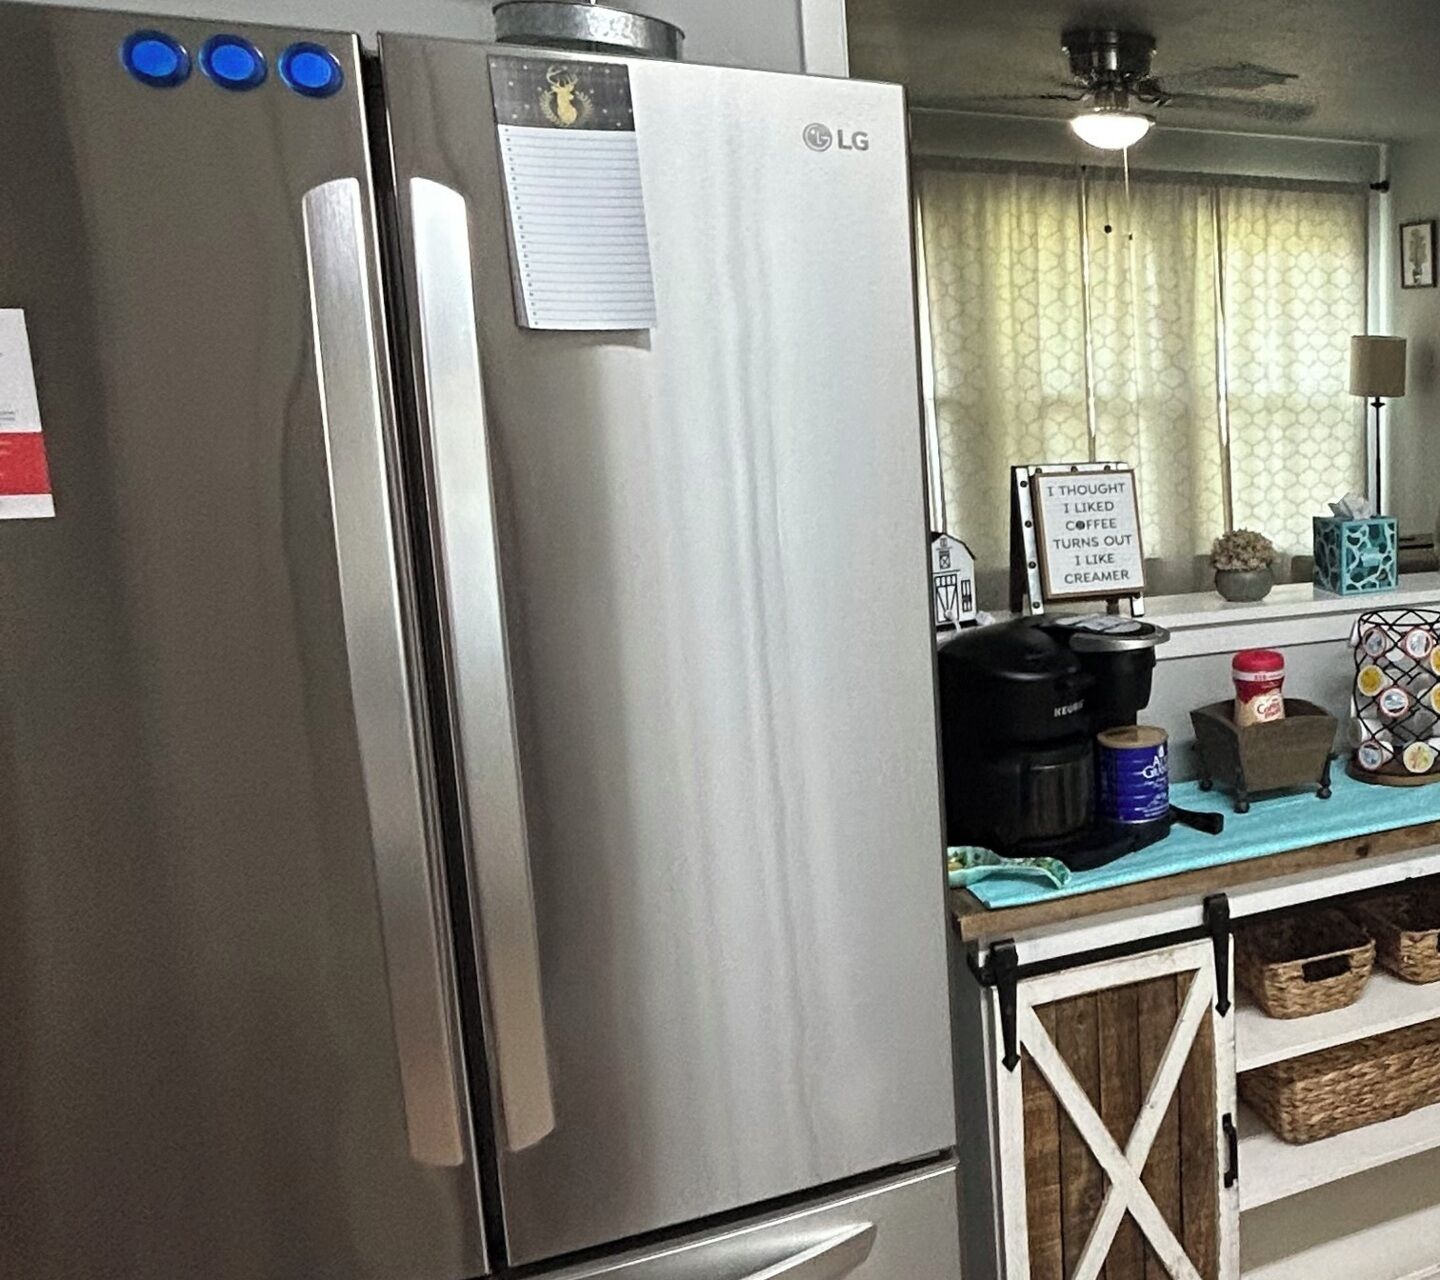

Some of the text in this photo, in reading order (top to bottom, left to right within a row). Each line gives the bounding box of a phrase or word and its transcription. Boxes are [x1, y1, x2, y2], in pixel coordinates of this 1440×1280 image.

[837, 129, 869, 151] LG
[1047, 482, 1125, 496] I THOUGHT
[1063, 501, 1114, 513] I LIKED
[1065, 518, 1117, 531] COFFEE
[1053, 535, 1132, 549] TURNS OUT
[1075, 553, 1115, 566] I LIKE
[1064, 570, 1130, 584] CREAMER
